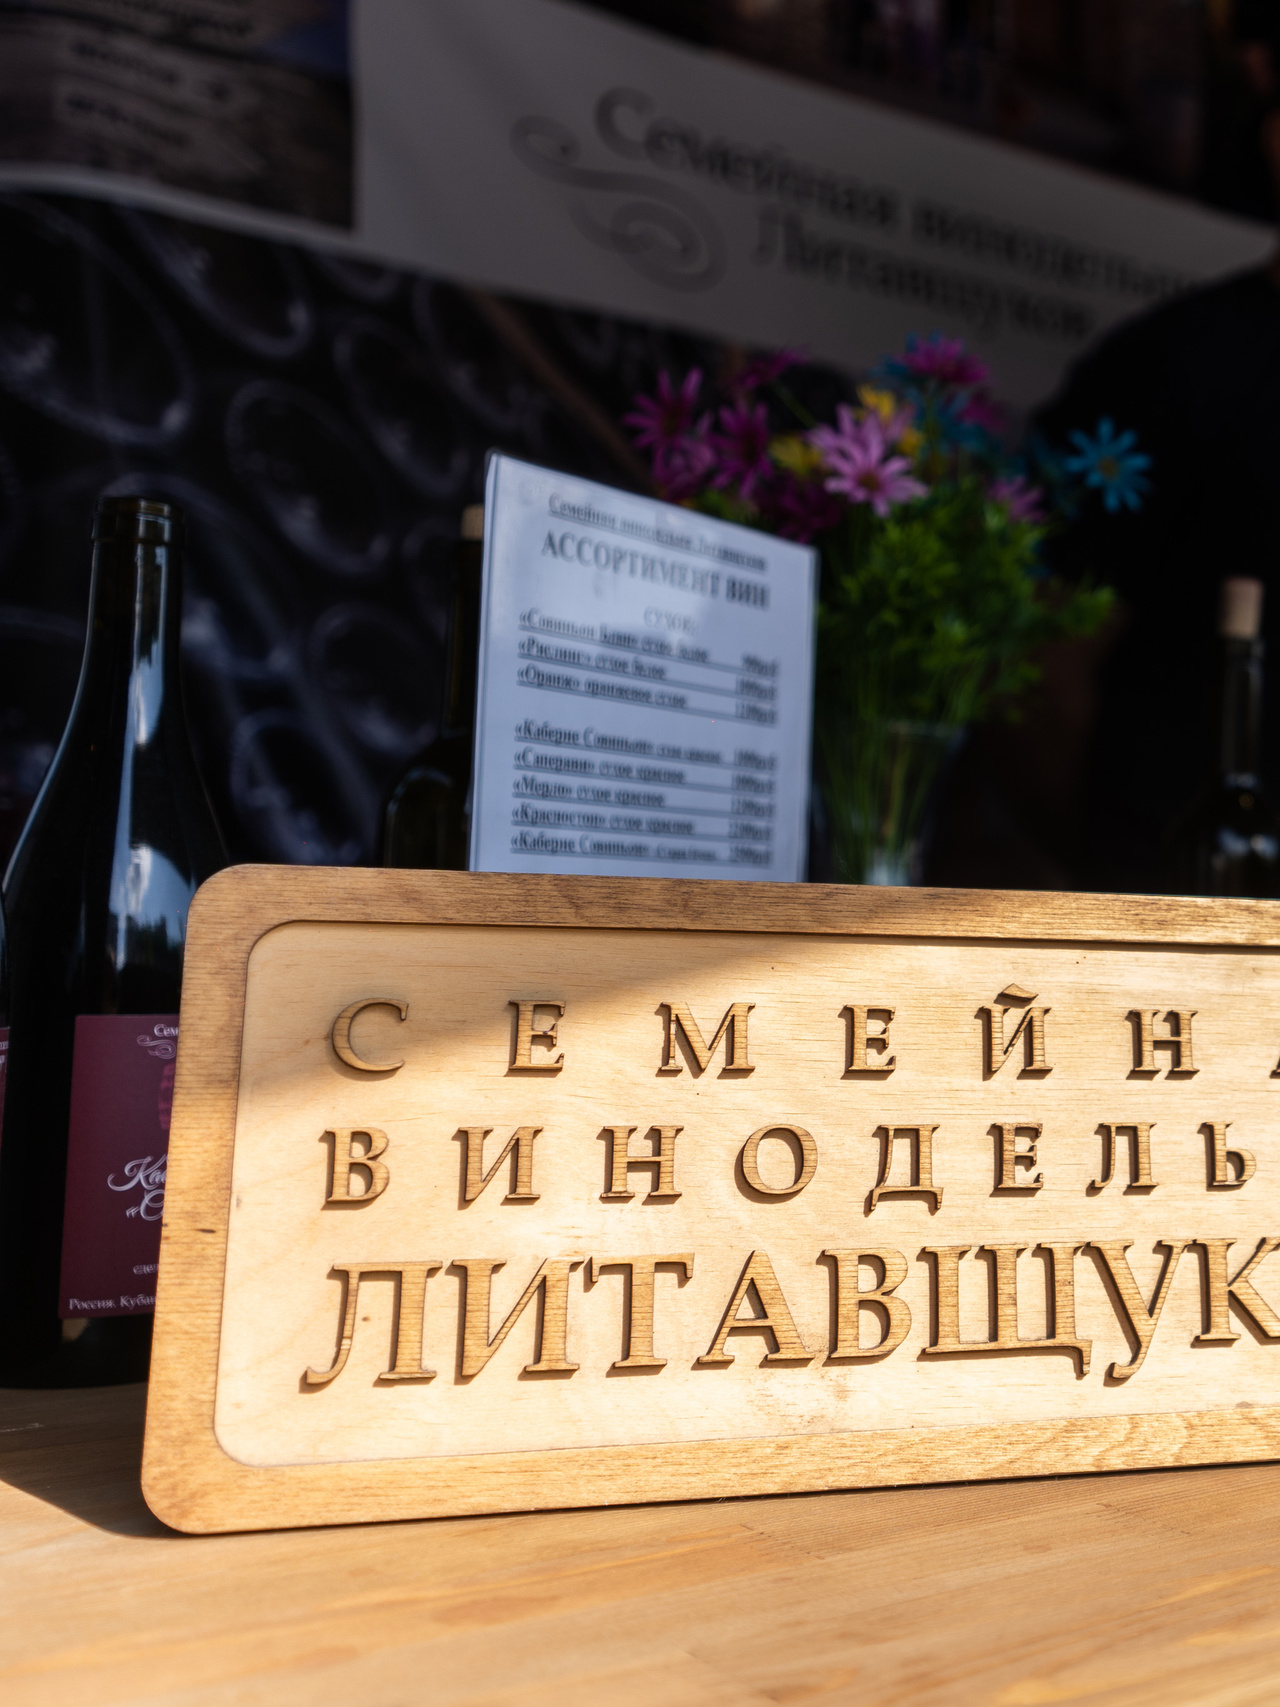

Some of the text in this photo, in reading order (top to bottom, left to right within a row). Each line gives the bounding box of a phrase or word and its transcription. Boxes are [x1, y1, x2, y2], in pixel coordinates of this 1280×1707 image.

[911, 194, 1197, 302] винодельн
[542, 530, 770, 610] АССОРТИМЕНТ ВИН
